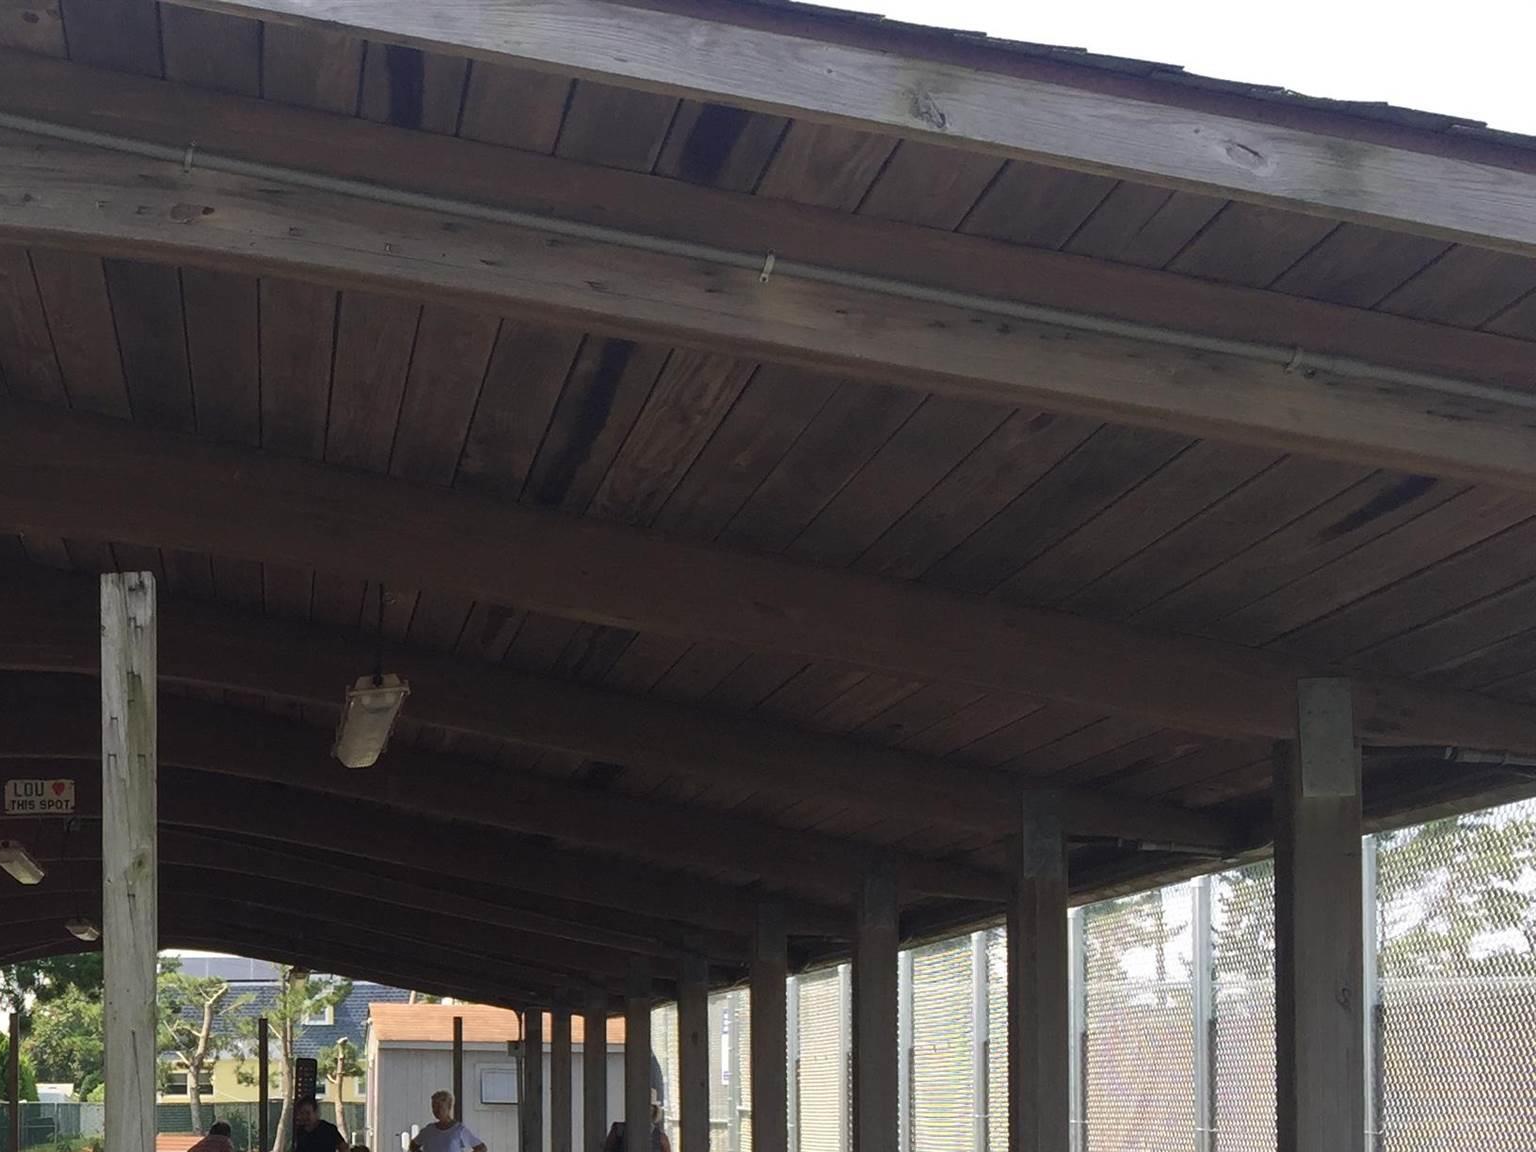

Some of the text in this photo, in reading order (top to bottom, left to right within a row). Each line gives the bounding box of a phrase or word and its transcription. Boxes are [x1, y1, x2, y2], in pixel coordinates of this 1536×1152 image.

[14, 782, 44, 797] LOU
[11, 799, 70, 810] THIS SPOT
